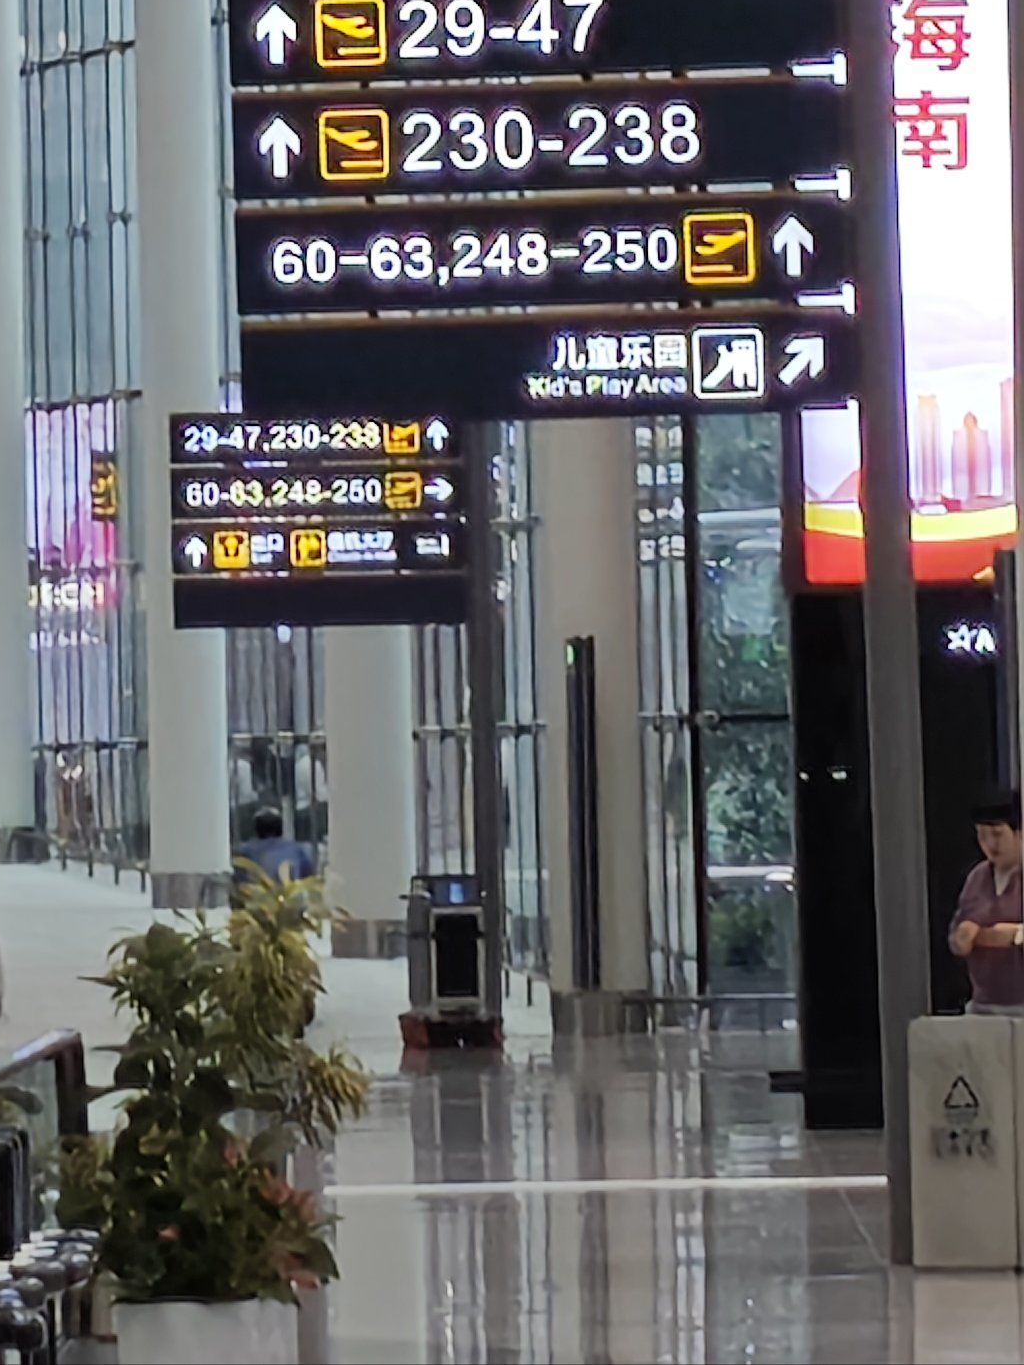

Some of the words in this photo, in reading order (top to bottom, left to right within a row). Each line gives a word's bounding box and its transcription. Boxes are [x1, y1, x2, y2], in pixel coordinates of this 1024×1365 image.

[402, 101, 702, 172] 230-238
[273, 229, 677, 288] 60-63,248-250
[552, 334, 688, 371] 儿童乐园
[585, 375, 633, 399] Play
[635, 373, 688, 395] Area
